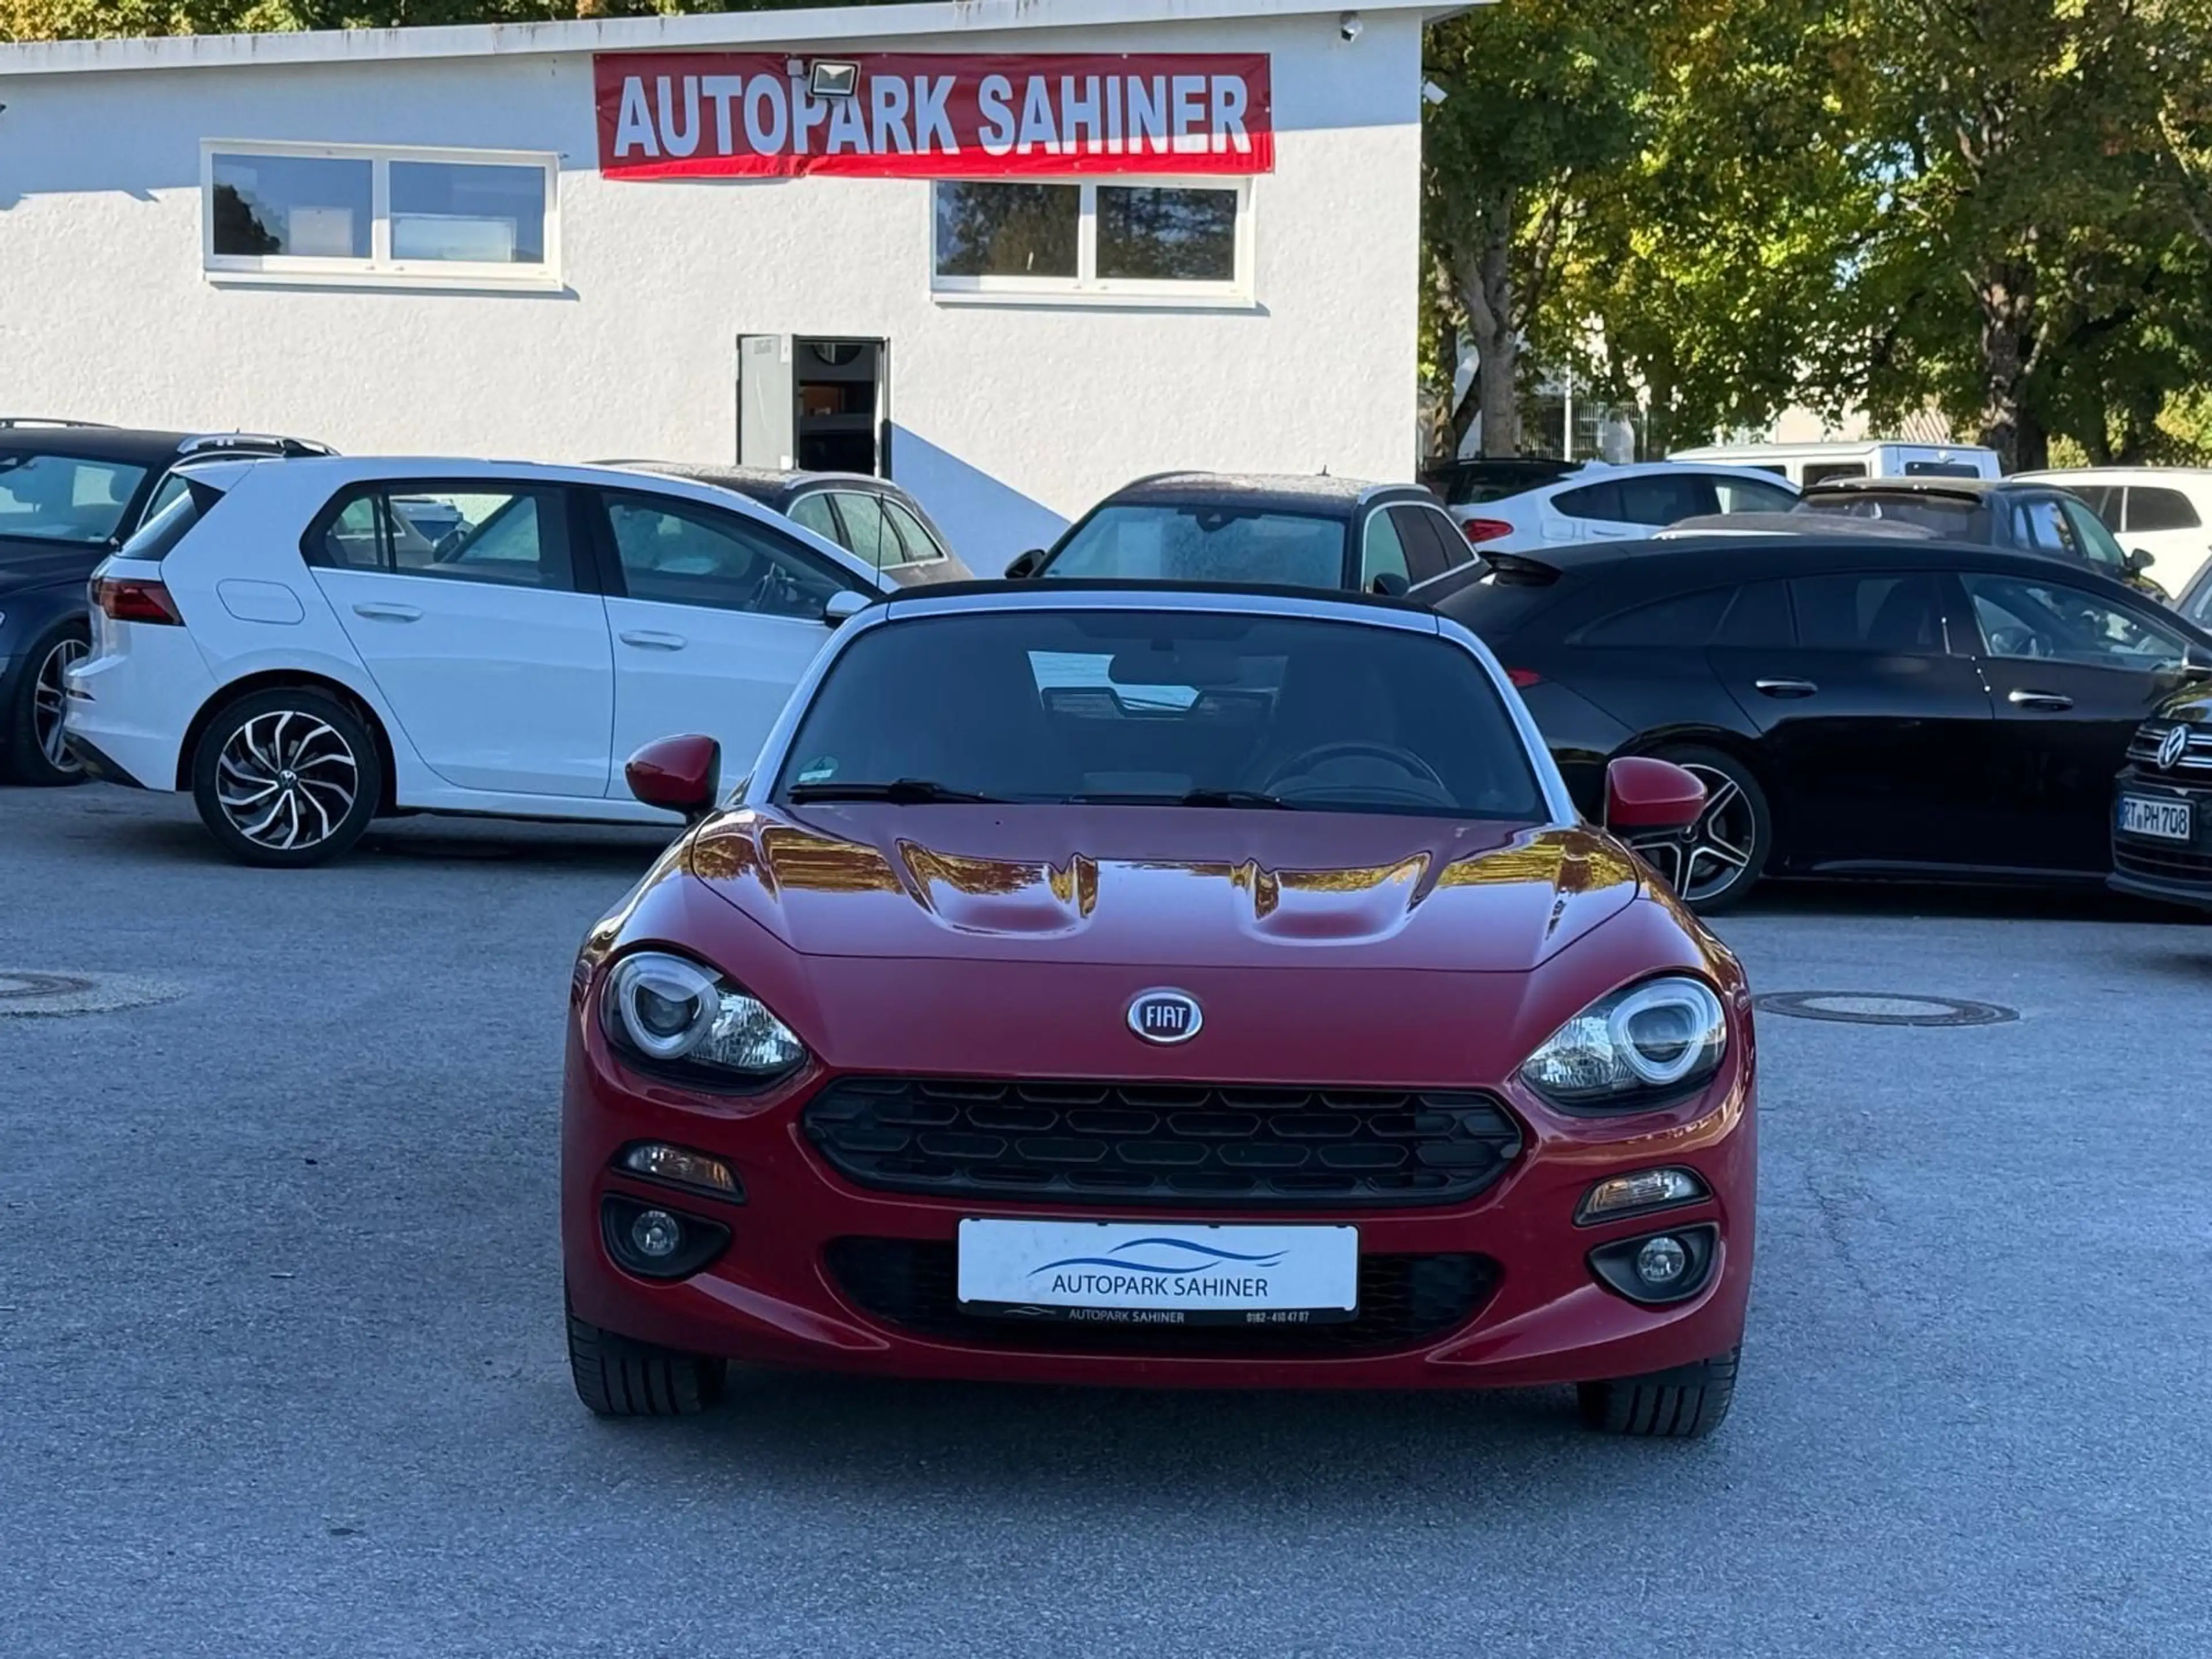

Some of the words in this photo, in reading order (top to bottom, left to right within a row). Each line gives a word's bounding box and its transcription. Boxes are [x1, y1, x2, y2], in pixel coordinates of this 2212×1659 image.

[614, 74, 960, 157] AUTOPARK
[978, 73, 1252, 156] SAHINER
[2161, 806, 2188, 835] 708
[1146, 1005, 1187, 1028] FIAT
[1051, 1274, 1168, 1296] AUTOPARK
[1174, 1277, 1268, 1297] SAHINER
[1069, 1309, 1129, 1321] AUTOPARK
[1131, 1310, 1184, 1324] SAHINER
